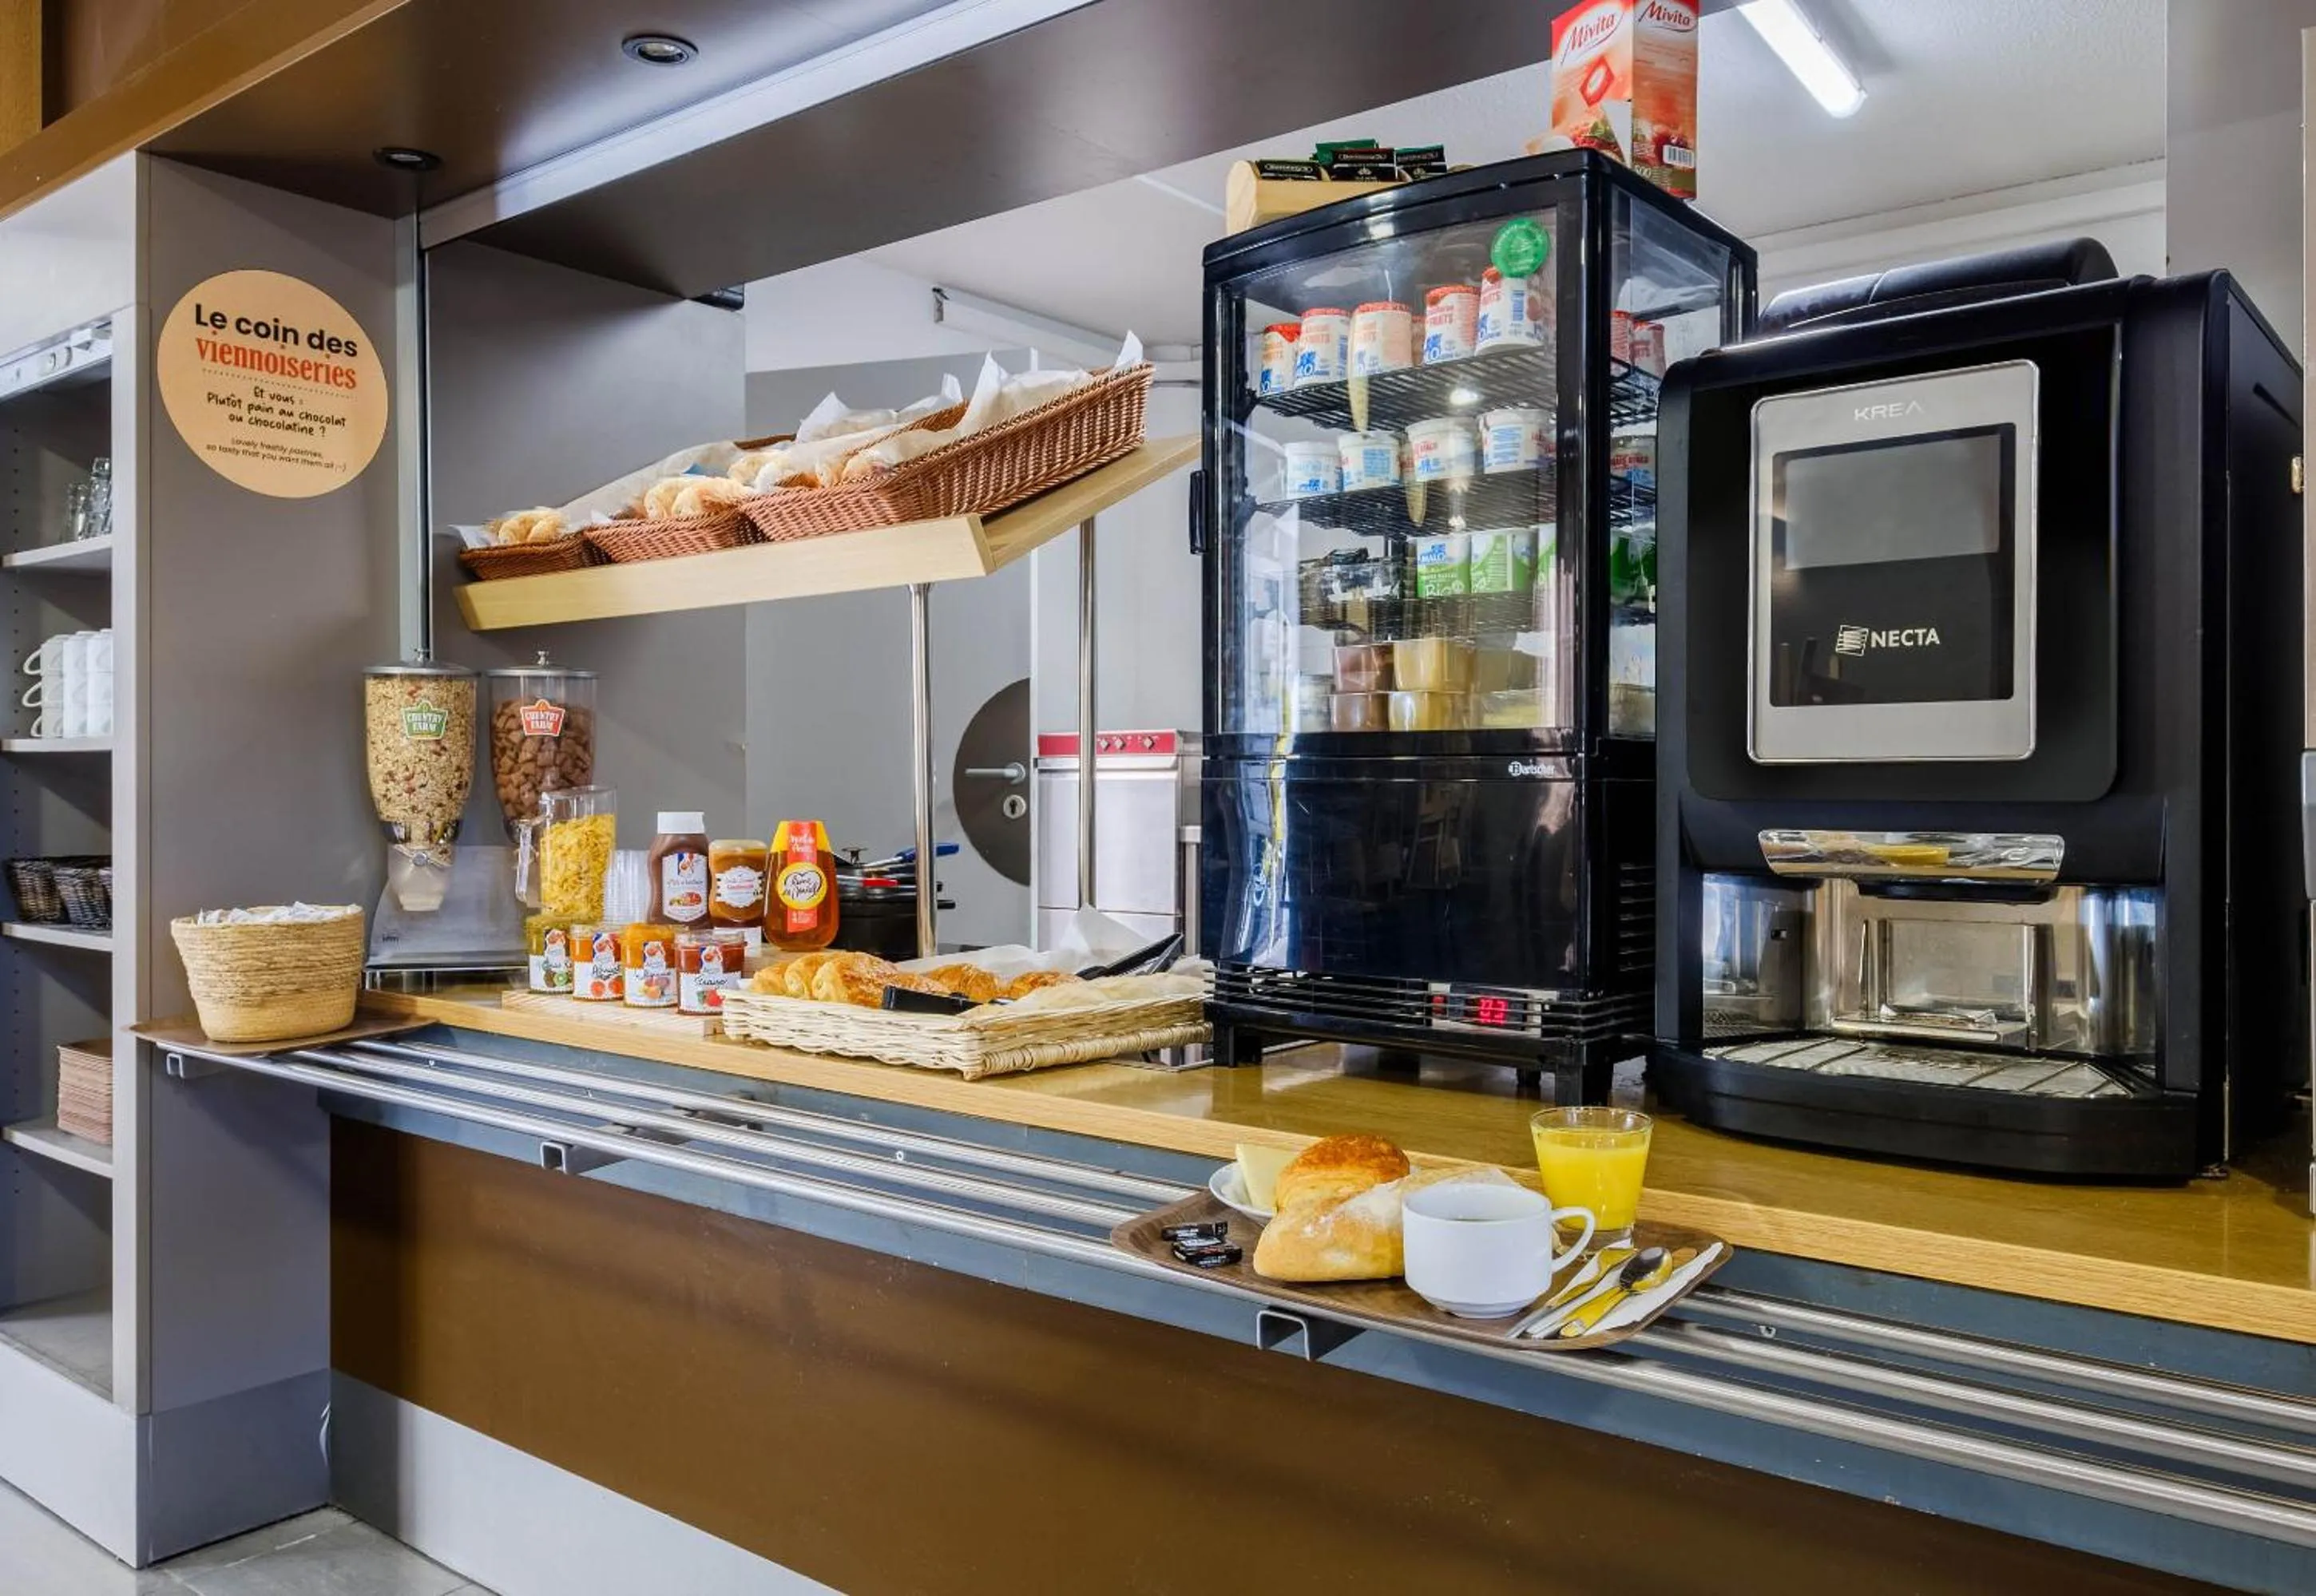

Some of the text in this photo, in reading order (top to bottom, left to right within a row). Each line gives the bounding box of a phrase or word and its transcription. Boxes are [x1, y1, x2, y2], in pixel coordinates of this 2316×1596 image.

[1638, 1, 1690, 26] Mivita
[1563, 13, 1616, 61] Mivita
[195, 303, 358, 358] Le coin des
[196, 331, 356, 390] viennoiseries
[207, 391, 346, 427] Plutôt pain au chocolat
[254, 386, 264, 398] Et
[270, 394, 295, 406] vous
[228, 414, 326, 438] ou chocolatine ?
[1870, 628, 1941, 649] NECTA
